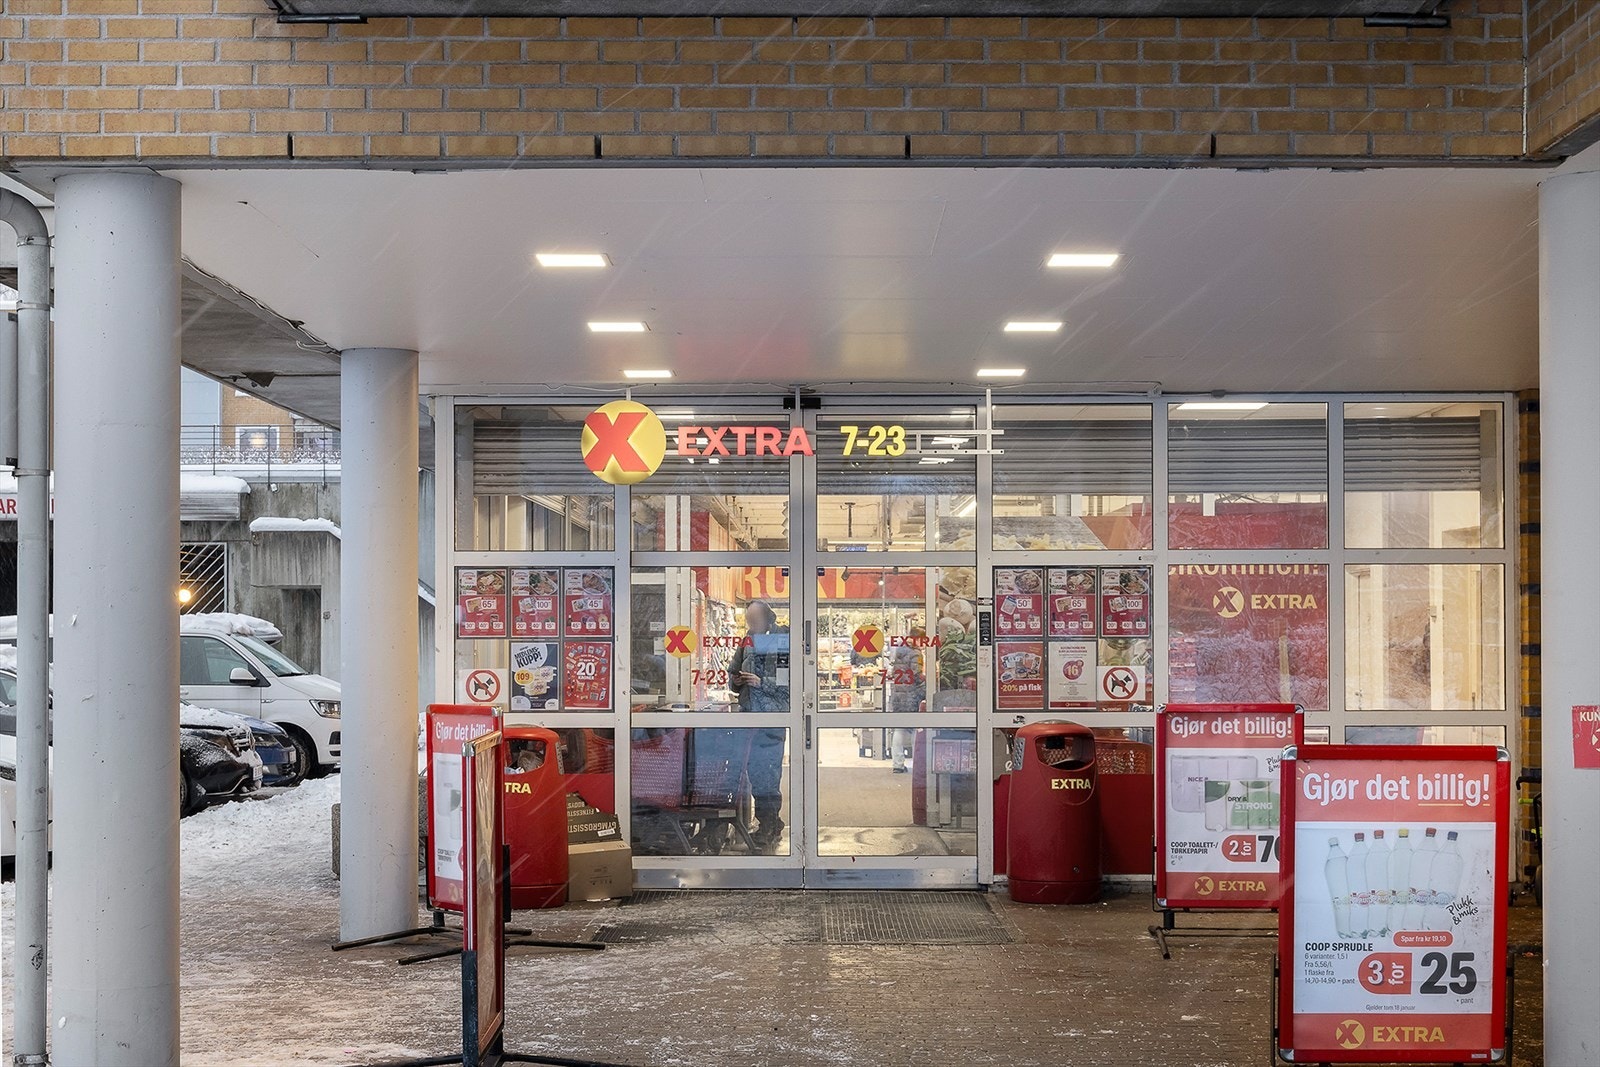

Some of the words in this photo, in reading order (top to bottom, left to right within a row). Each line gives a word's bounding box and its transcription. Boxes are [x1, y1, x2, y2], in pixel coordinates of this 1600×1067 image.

[677, 426, 814, 457] EXTRA
[840, 424, 907, 457] 7-23
[1251, 594, 1318, 610] EXTRA
[702, 635, 755, 648] EXTRA
[890, 634, 942, 648] EXTRA
[516, 651, 543, 668] KUPP!
[517, 672, 530, 681] 109
[577, 661, 596, 676] 20
[691, 669, 728, 685] 7-23
[879, 669, 915, 685] 7-23
[1018, 684, 1027, 692] på
[435, 721, 453, 743] Gjør
[454, 723, 469, 741] det
[1170, 716, 1207, 738] Gjør
[1211, 717, 1240, 735] det
[1245, 716, 1292, 738] billig!
[1051, 778, 1092, 790] EXTRA
[1302, 772, 1359, 807] Gjør
[1365, 773, 1411, 801] det
[1417, 772, 1490, 807] billig!
[1234, 802, 1273, 810] STRONG
[1228, 840, 1239, 856] 2
[1240, 841, 1252, 856] for
[1218, 880, 1267, 892] EXTRA
[1445, 895, 1475, 916] Plukk
[1452, 915, 1462, 926] &
[1458, 906, 1479, 918] miks
[1304, 942, 1331, 952] COOP
[1331, 942, 1373, 952] SPRUDLE
[1400, 935, 1415, 943] Spar
[1431, 935, 1447, 943] 19,10
[1367, 959, 1384, 985] 3
[1388, 962, 1405, 986] for
[1419, 951, 1478, 995] 25
[1365, 1004, 1383, 1012] Gjelder
[1400, 1004, 1416, 1012] januar
[1460, 997, 1474, 1005] pant
[1372, 1026, 1445, 1043] EXTRA
